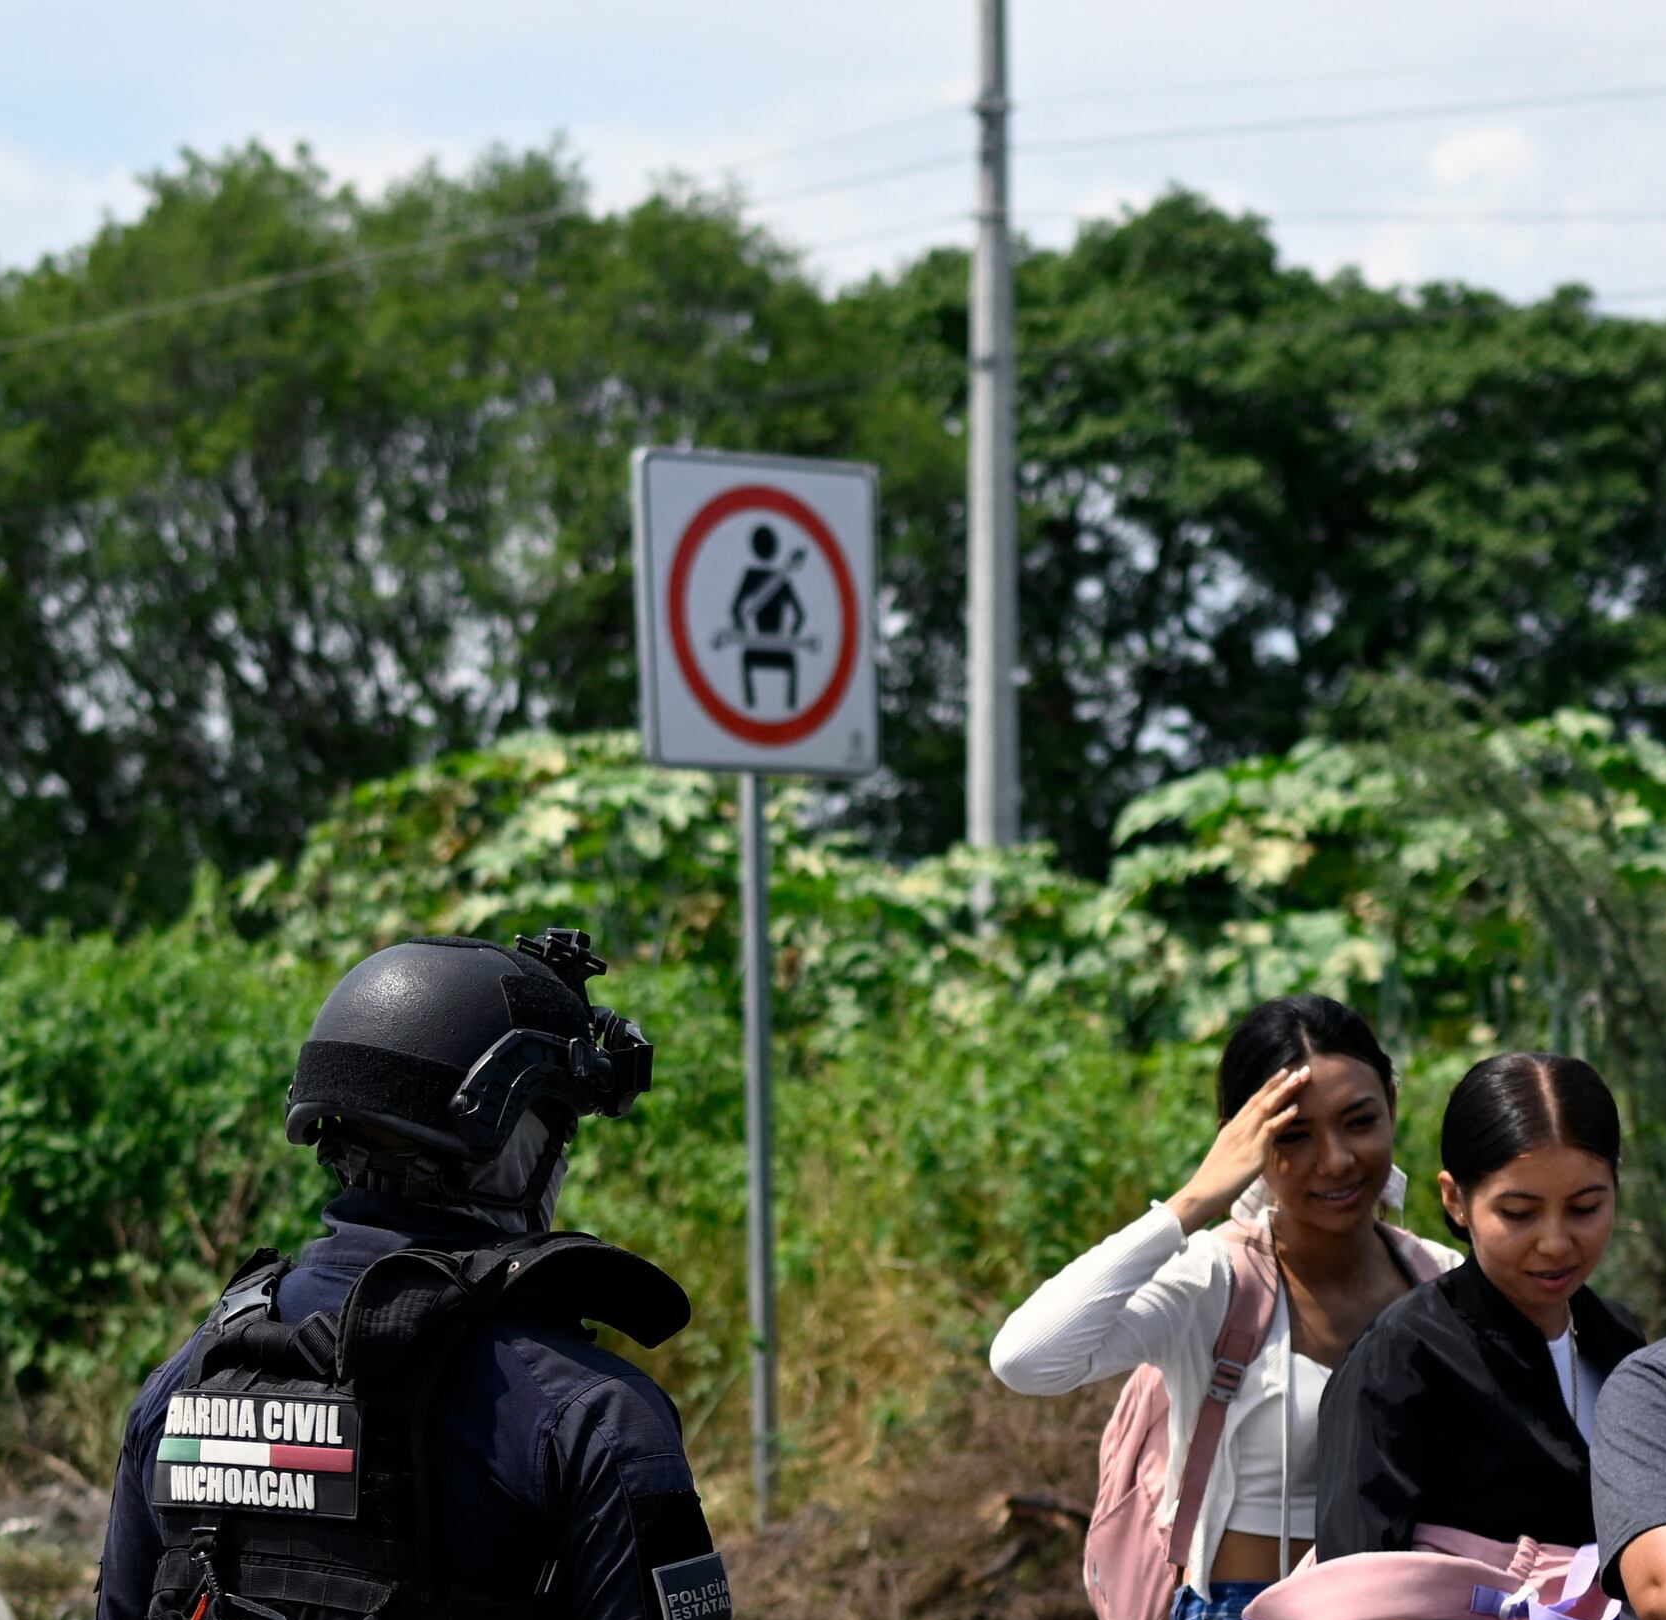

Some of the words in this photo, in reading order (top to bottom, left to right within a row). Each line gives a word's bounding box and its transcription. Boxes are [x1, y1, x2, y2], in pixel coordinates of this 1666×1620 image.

[165, 1396, 257, 1439] UARDIA
[262, 1400, 343, 1445] CIVIL
[169, 1465, 316, 1511] MICHOACAN
